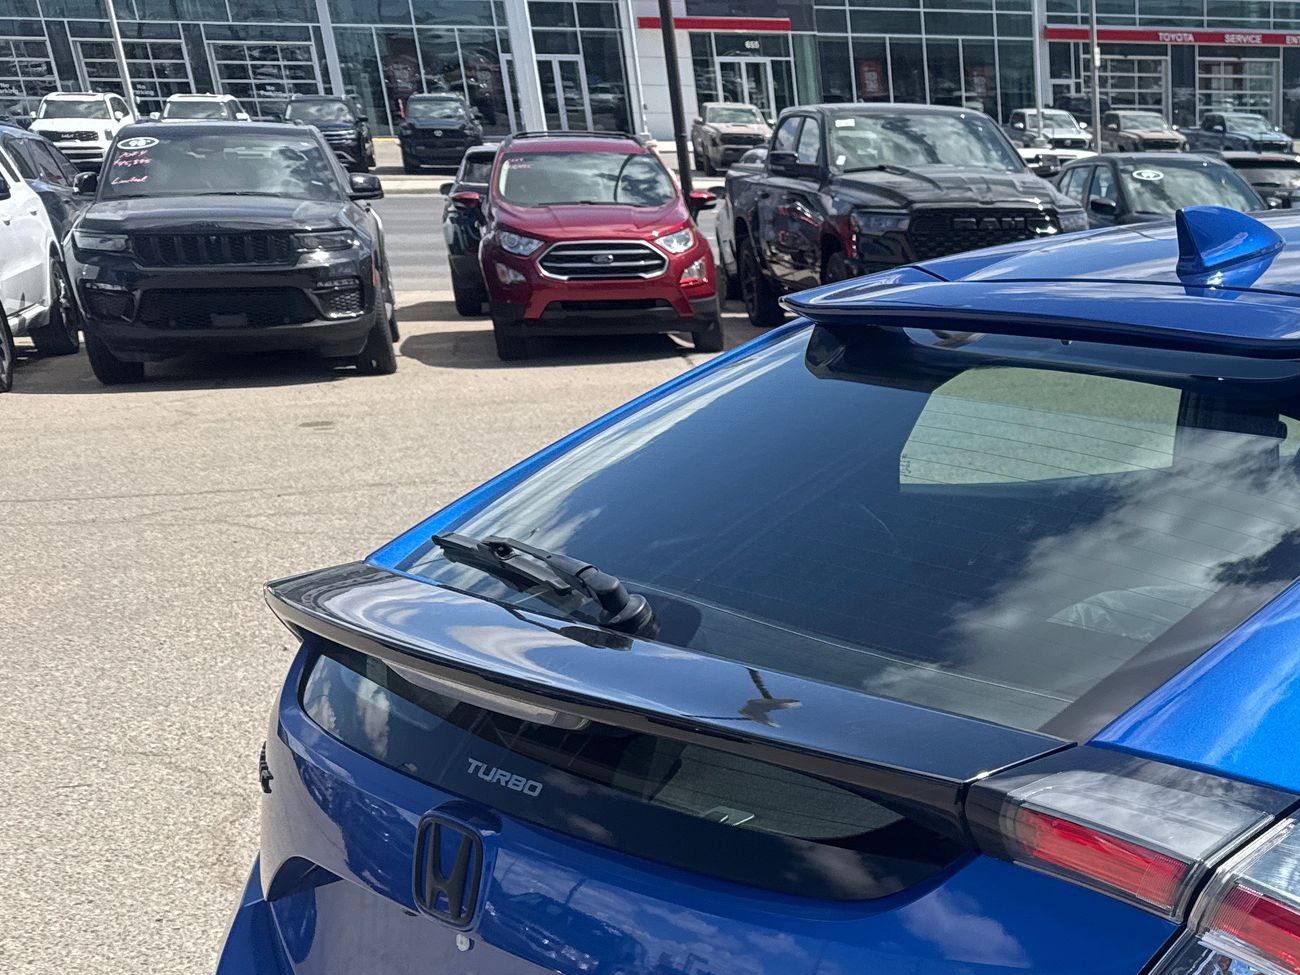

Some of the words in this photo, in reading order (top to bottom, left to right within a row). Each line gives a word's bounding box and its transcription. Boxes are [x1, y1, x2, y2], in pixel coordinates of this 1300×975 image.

[1158, 32, 1195, 42] TOYOTA
[1224, 33, 1262, 44] SERVICE
[953, 217, 1025, 231] RAM
[467, 757, 544, 797] TURBO
